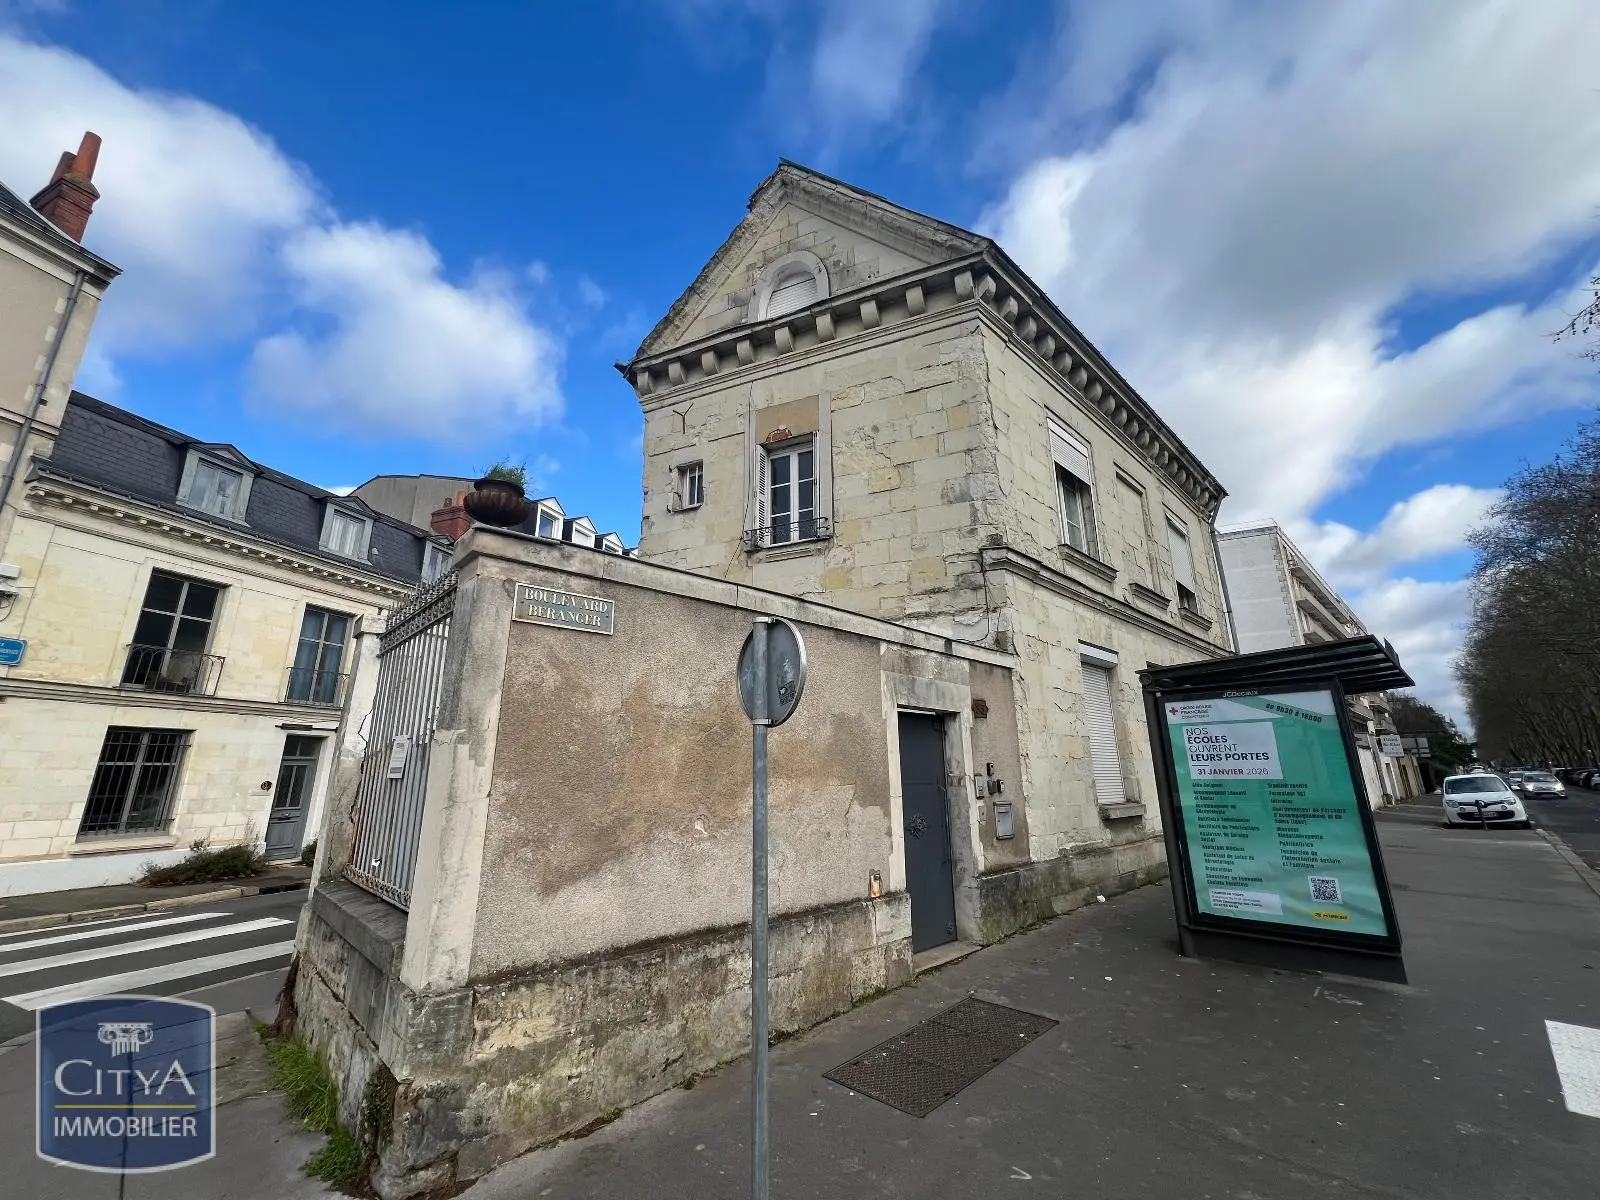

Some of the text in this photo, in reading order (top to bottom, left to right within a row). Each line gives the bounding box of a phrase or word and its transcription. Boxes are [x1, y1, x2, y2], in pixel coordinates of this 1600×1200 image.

[525, 588, 608, 612] BOULEVARD
[528, 604, 600, 626] BERANGER
[1186, 728, 1208, 736] NOS
[1189, 744, 1238, 752] OUVRENT
[1225, 752, 1269, 760] PORTES
